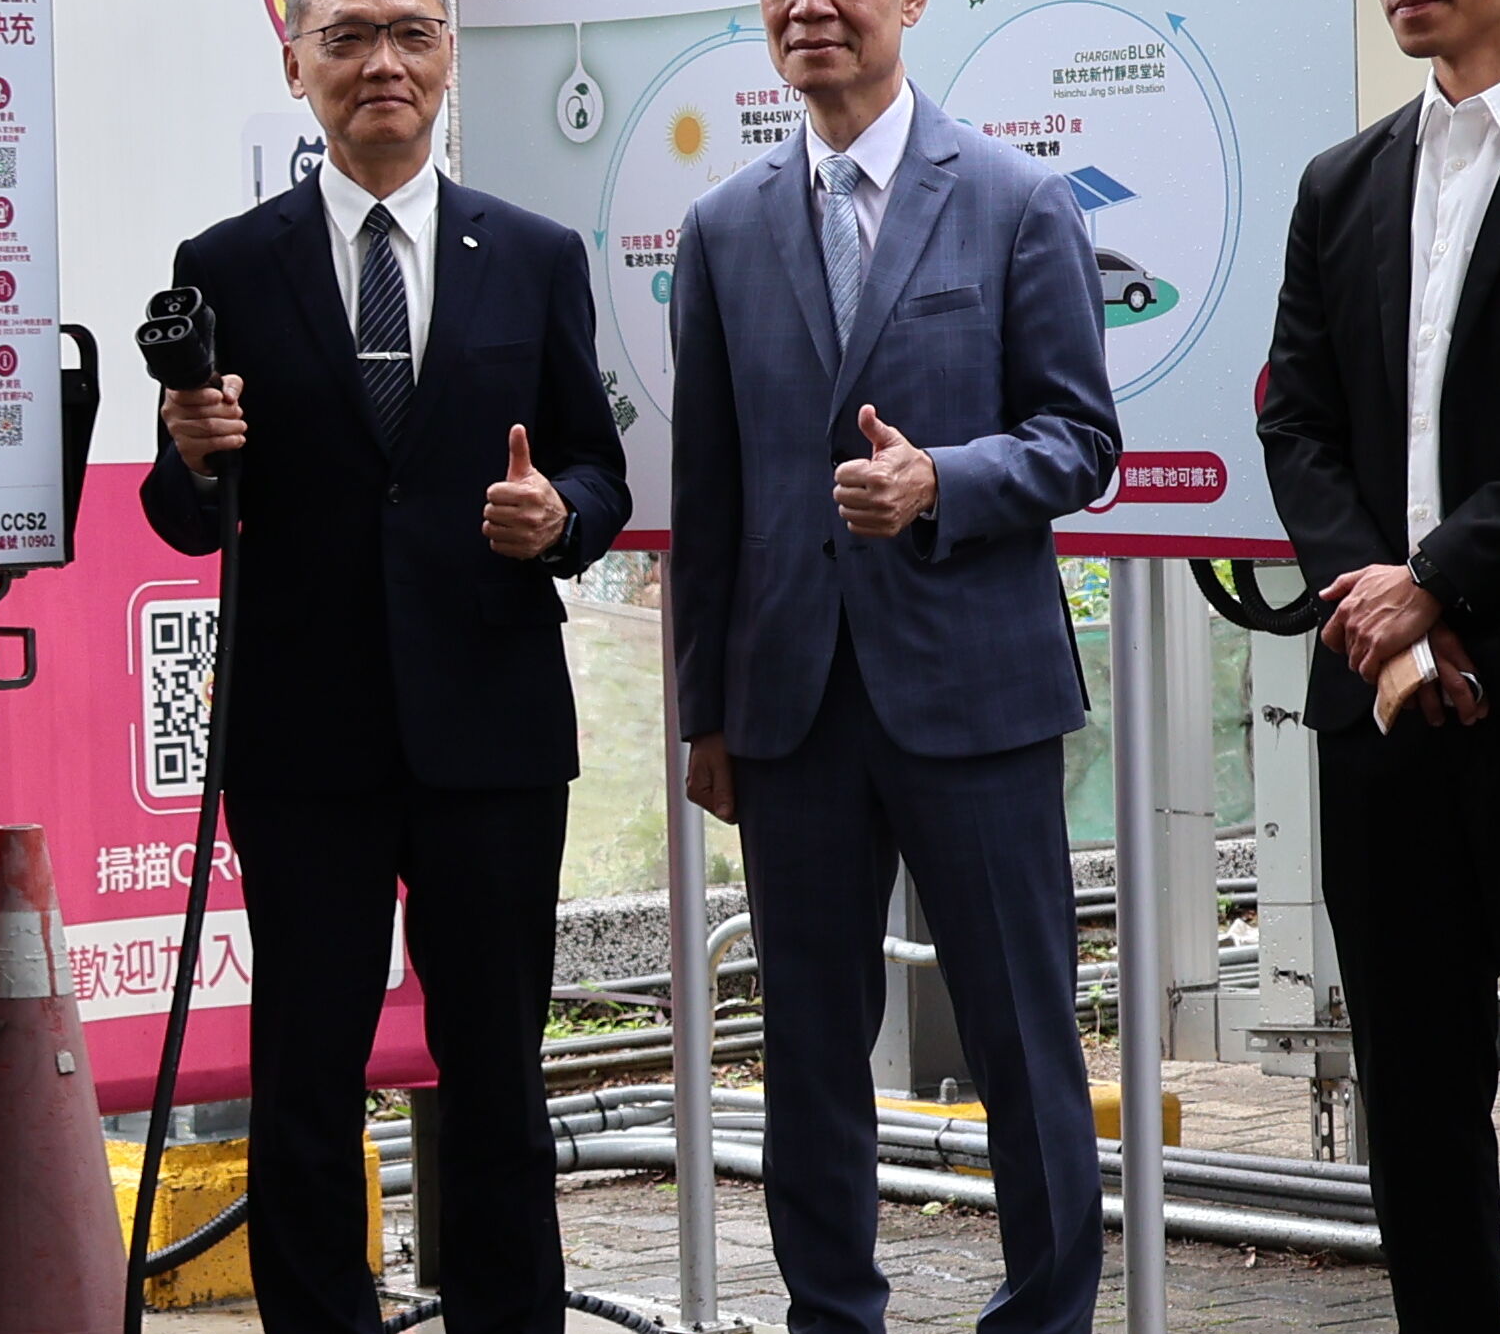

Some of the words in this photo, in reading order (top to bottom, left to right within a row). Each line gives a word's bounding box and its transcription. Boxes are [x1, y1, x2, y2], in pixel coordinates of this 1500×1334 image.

[1074, 48, 1127, 64] CHARGING
[1052, 63, 1166, 85] 區快充新竹靜思堂站
[735, 89, 780, 106] 每日發電
[1053, 88, 1087, 99] Hsinchu
[1088, 86, 1106, 98] Jing
[1107, 85, 1116, 96] Si
[1118, 84, 1134, 95] Hall
[1135, 83, 1166, 94] Station
[982, 120, 1042, 137] 每小時可充
[1043, 113, 1066, 134] 30
[1069, 118, 1083, 134] 度
[620, 233, 664, 249] 可用容量
[1124, 467, 1218, 487] 儲能電池可擴充
[1, 512, 48, 532] CCS2
[21, 534, 56, 549] 10902
[96, 840, 244, 895] 掃描QR
